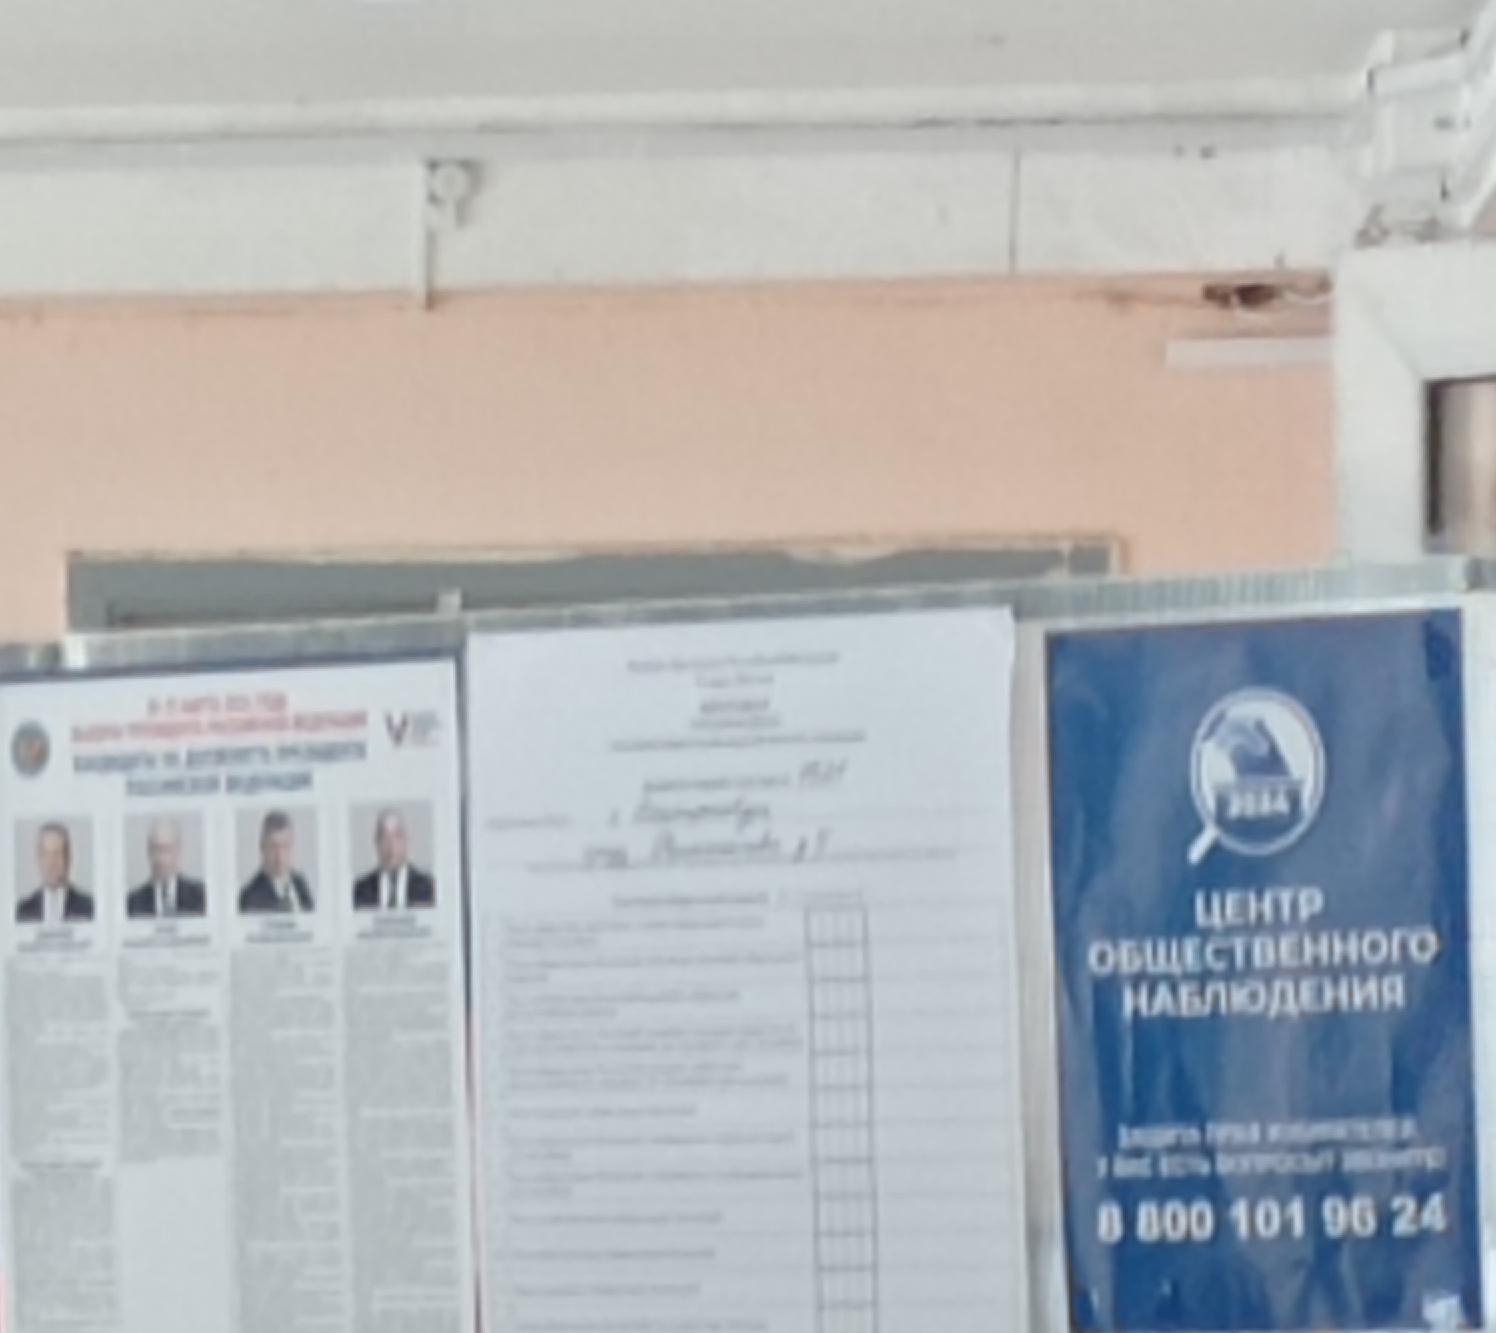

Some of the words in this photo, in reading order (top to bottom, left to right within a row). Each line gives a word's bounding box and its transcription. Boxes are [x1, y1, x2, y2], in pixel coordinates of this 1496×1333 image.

[1194, 886, 1324, 932] ЦЕНТР
[1088, 925, 1439, 977] ОБЩЕСТВЕННОГО
[1122, 972, 1405, 1021] НАБЛЮДЕНИЯ
[1097, 1200, 1123, 1244] 8
[1137, 1198, 1214, 1243] 800
[1229, 1196, 1305, 1241] 101
[1390, 1192, 1447, 1239] 24
